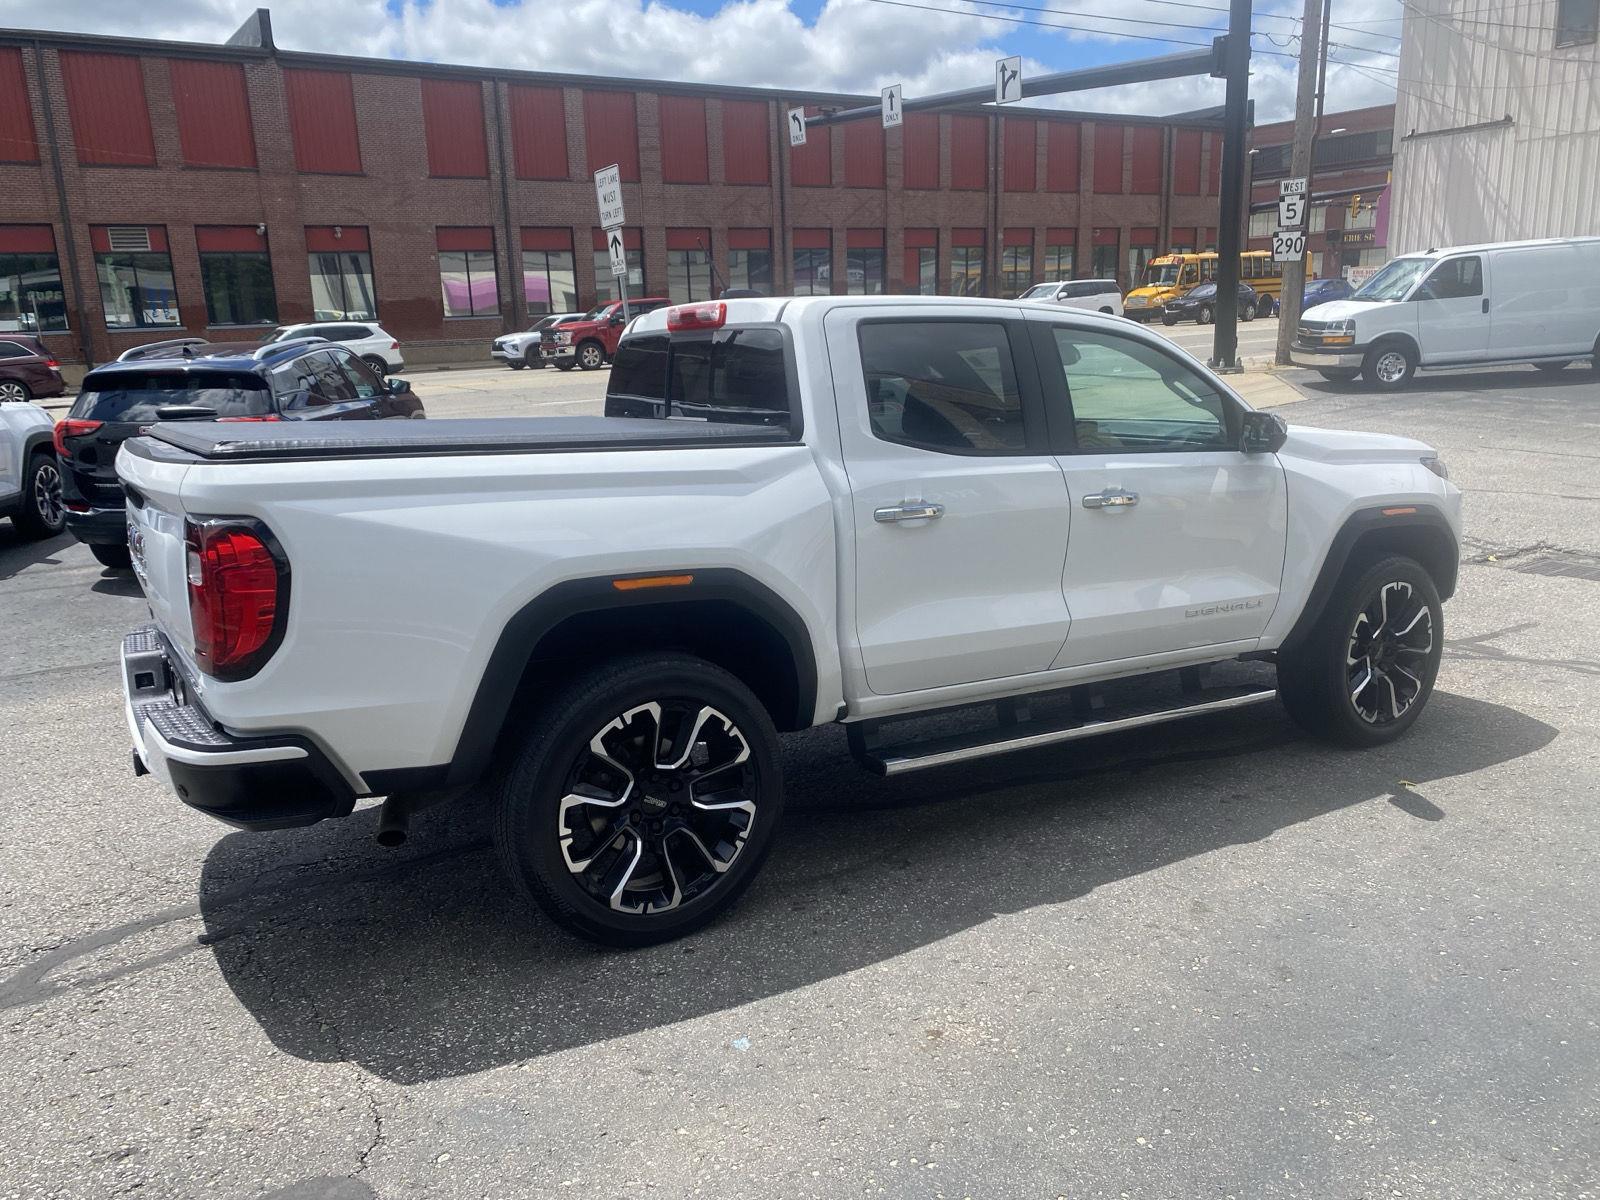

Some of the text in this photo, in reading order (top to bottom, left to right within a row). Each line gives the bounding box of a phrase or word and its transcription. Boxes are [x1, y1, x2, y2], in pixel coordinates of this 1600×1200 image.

[885, 113, 899, 122] ONLY
[792, 134, 804, 142] ONLY
[598, 173, 618, 188] LEFT LANE
[1283, 181, 1304, 193] WEST
[603, 190, 616, 204] MUST
[601, 207, 622, 221] TURN LEFT
[1286, 203, 1297, 220] 5
[1275, 237, 1303, 255] 290
[1185, 599, 1263, 618] DENALI
